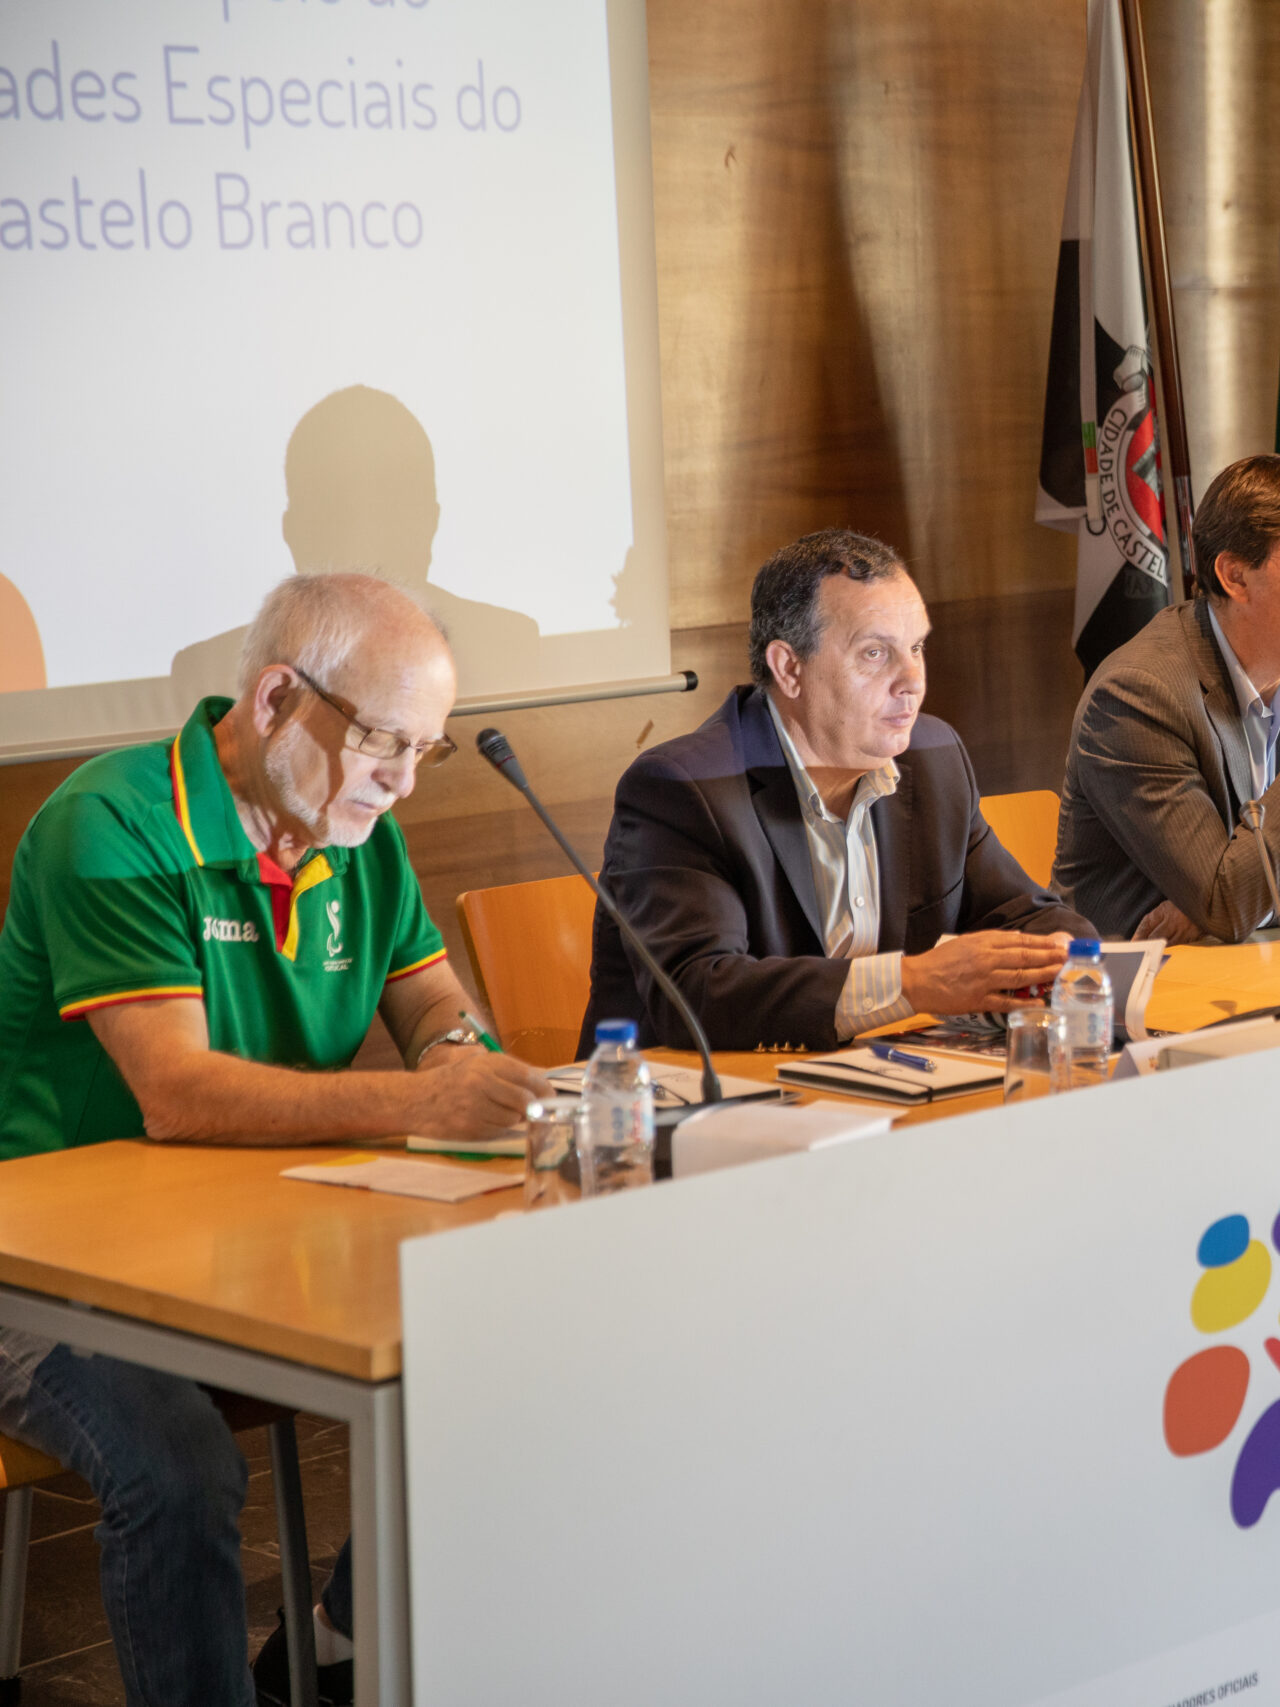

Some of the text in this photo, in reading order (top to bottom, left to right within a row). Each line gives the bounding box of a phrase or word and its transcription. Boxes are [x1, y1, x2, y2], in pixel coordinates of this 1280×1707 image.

[163, 45, 438, 150] Especiais
[456, 59, 523, 133] do
[215, 172, 424, 250] Branco
[1100, 408, 1127, 486] CIDADE
[1103, 487, 1122, 516] DE
[1218, 1672, 1258, 1700] OFICIAIS
